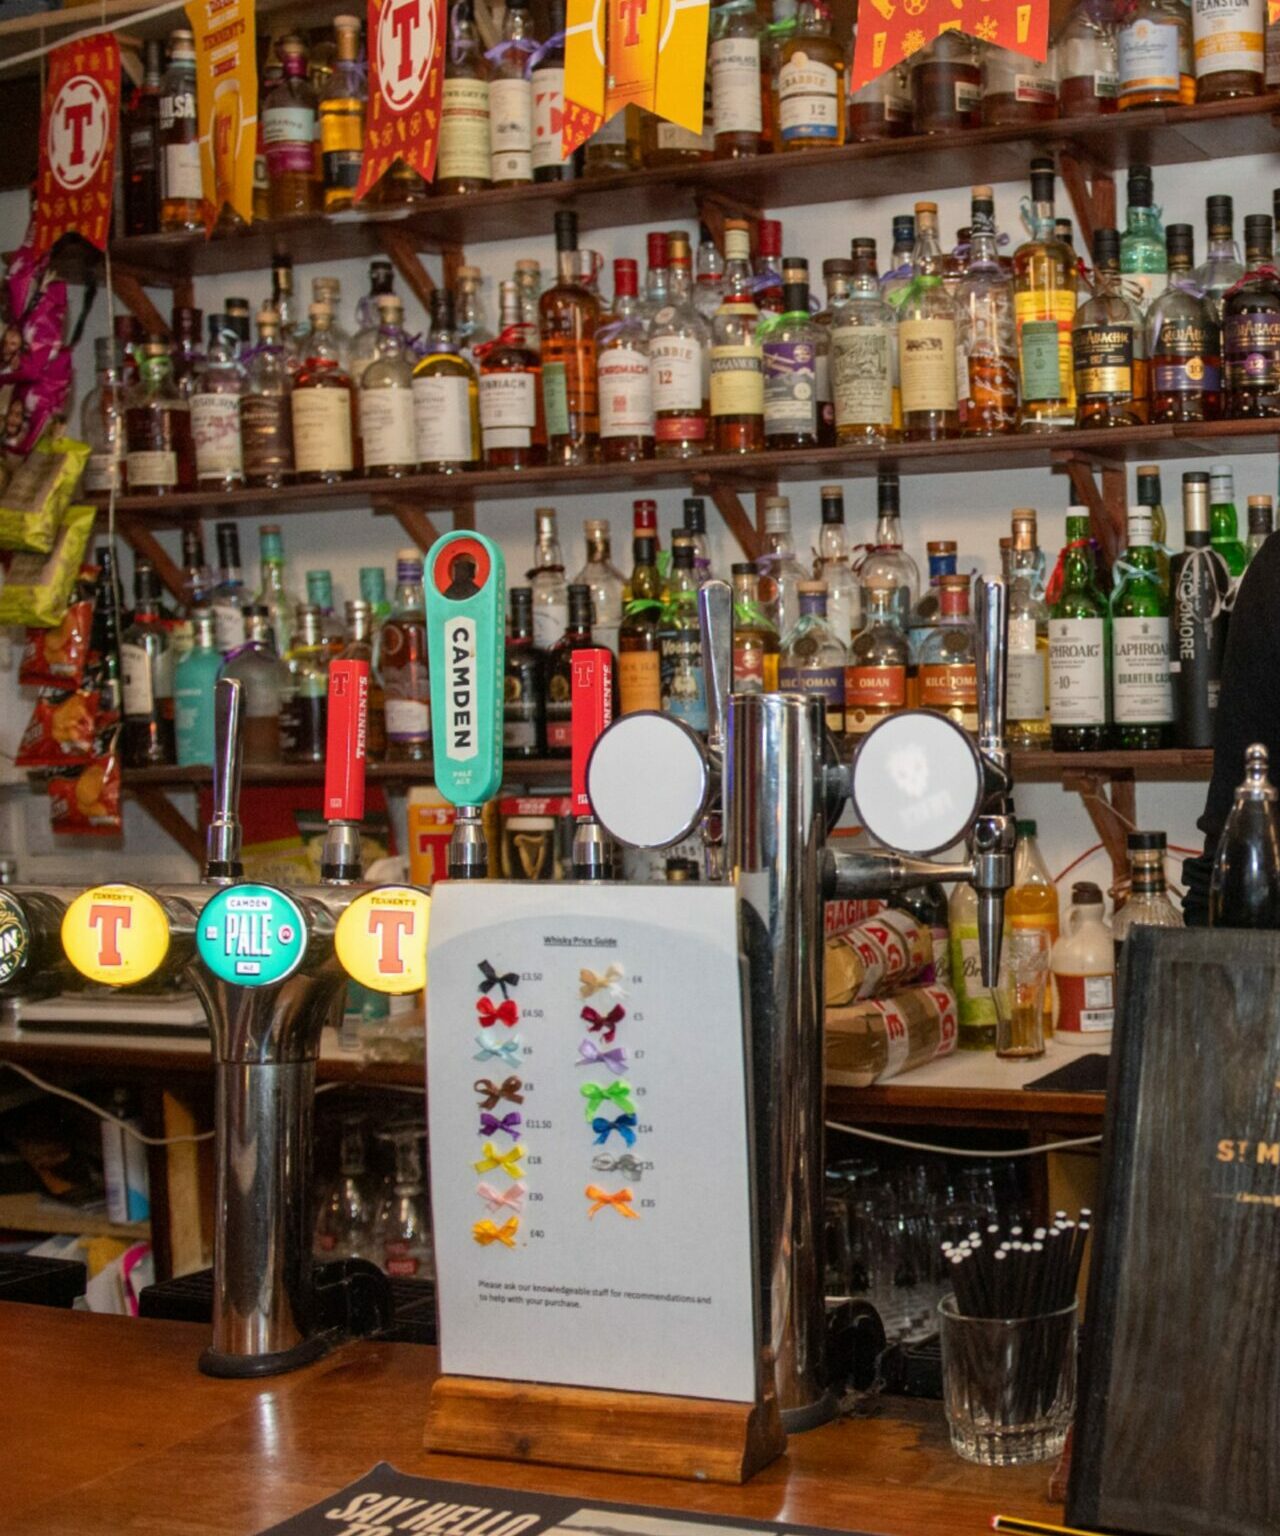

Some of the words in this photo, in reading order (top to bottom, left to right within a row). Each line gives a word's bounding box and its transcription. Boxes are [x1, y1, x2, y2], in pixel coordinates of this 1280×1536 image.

[811, 104, 826, 116] 12
[64, 102, 93, 166] T
[1250, 358, 1265, 369] 12
[658, 371, 673, 385] 12
[574, 660, 594, 687] T
[1119, 673, 1153, 684] QUARTER
[332, 672, 348, 695] T
[452, 626, 471, 749] CAMDEN
[781, 677, 837, 688] KILCOMAN
[1059, 675, 1070, 689] 10
[356, 676, 368, 759] TENNENT'S
[93, 892, 133, 901] TENNENT'S
[229, 899, 268, 908] CAMDEN
[371, 896, 417, 907] TENNENT'S
[88, 905, 131, 966] T
[224, 914, 272, 957] PALE
[368, 910, 415, 974] T
[544, 936, 572, 947] Whisky
[573, 936, 593, 946] Price
[595, 937, 618, 947] Guide
[522, 973, 543, 982] £3.50
[632, 975, 642, 984] £4
[522, 1009, 544, 1018] £4.50
[634, 1013, 644, 1022] £5
[523, 1047, 533, 1055] £6
[635, 1050, 645, 1059] £7
[636, 1087, 647, 1096] £9
[526, 1120, 552, 1129] £11.50
[638, 1125, 653, 1134] £14
[527, 1156, 542, 1165] £18
[529, 1192, 543, 1202] £30
[641, 1199, 656, 1208] £35
[530, 1229, 545, 1239] £40
[478, 1280, 502, 1290] Please
[504, 1282, 516, 1291] ask
[533, 1283, 590, 1297] knowledgeable
[592, 1288, 609, 1297] staff
[610, 1289, 622, 1298] for
[623, 1291, 696, 1304] recommendations
[697, 1296, 712, 1304] and
[479, 1293, 489, 1301] to
[490, 1293, 506, 1304] help
[508, 1294, 524, 1303] with
[526, 1298, 544, 1307] your
[544, 1297, 582, 1309] purchase.
[325, 1493, 429, 1525] SAY
[397, 1501, 541, 1536] HELLO
